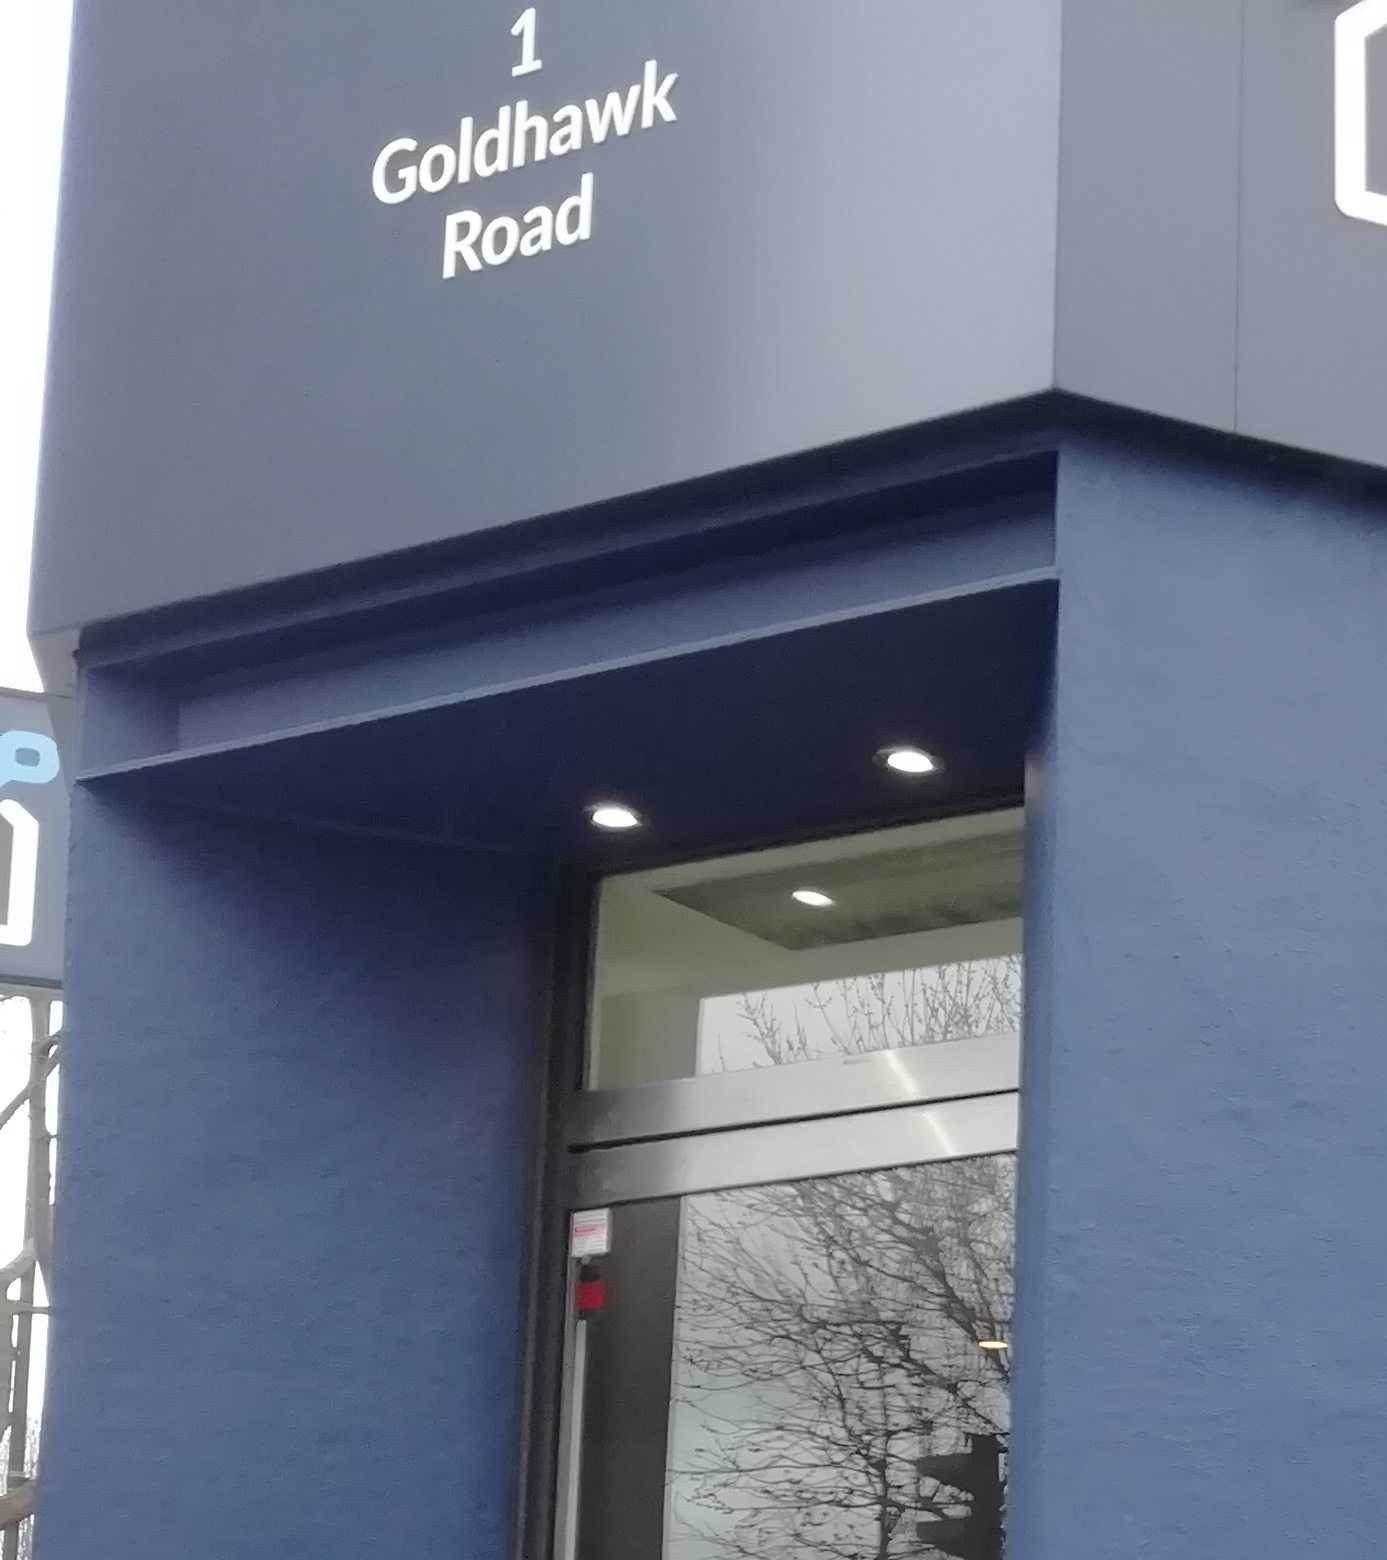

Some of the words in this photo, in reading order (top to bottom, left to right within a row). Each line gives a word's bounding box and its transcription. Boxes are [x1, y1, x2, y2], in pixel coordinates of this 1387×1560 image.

[509, 7, 542, 77] 1
[371, 59, 679, 204] Goldhawk
[442, 173, 593, 278] Road
